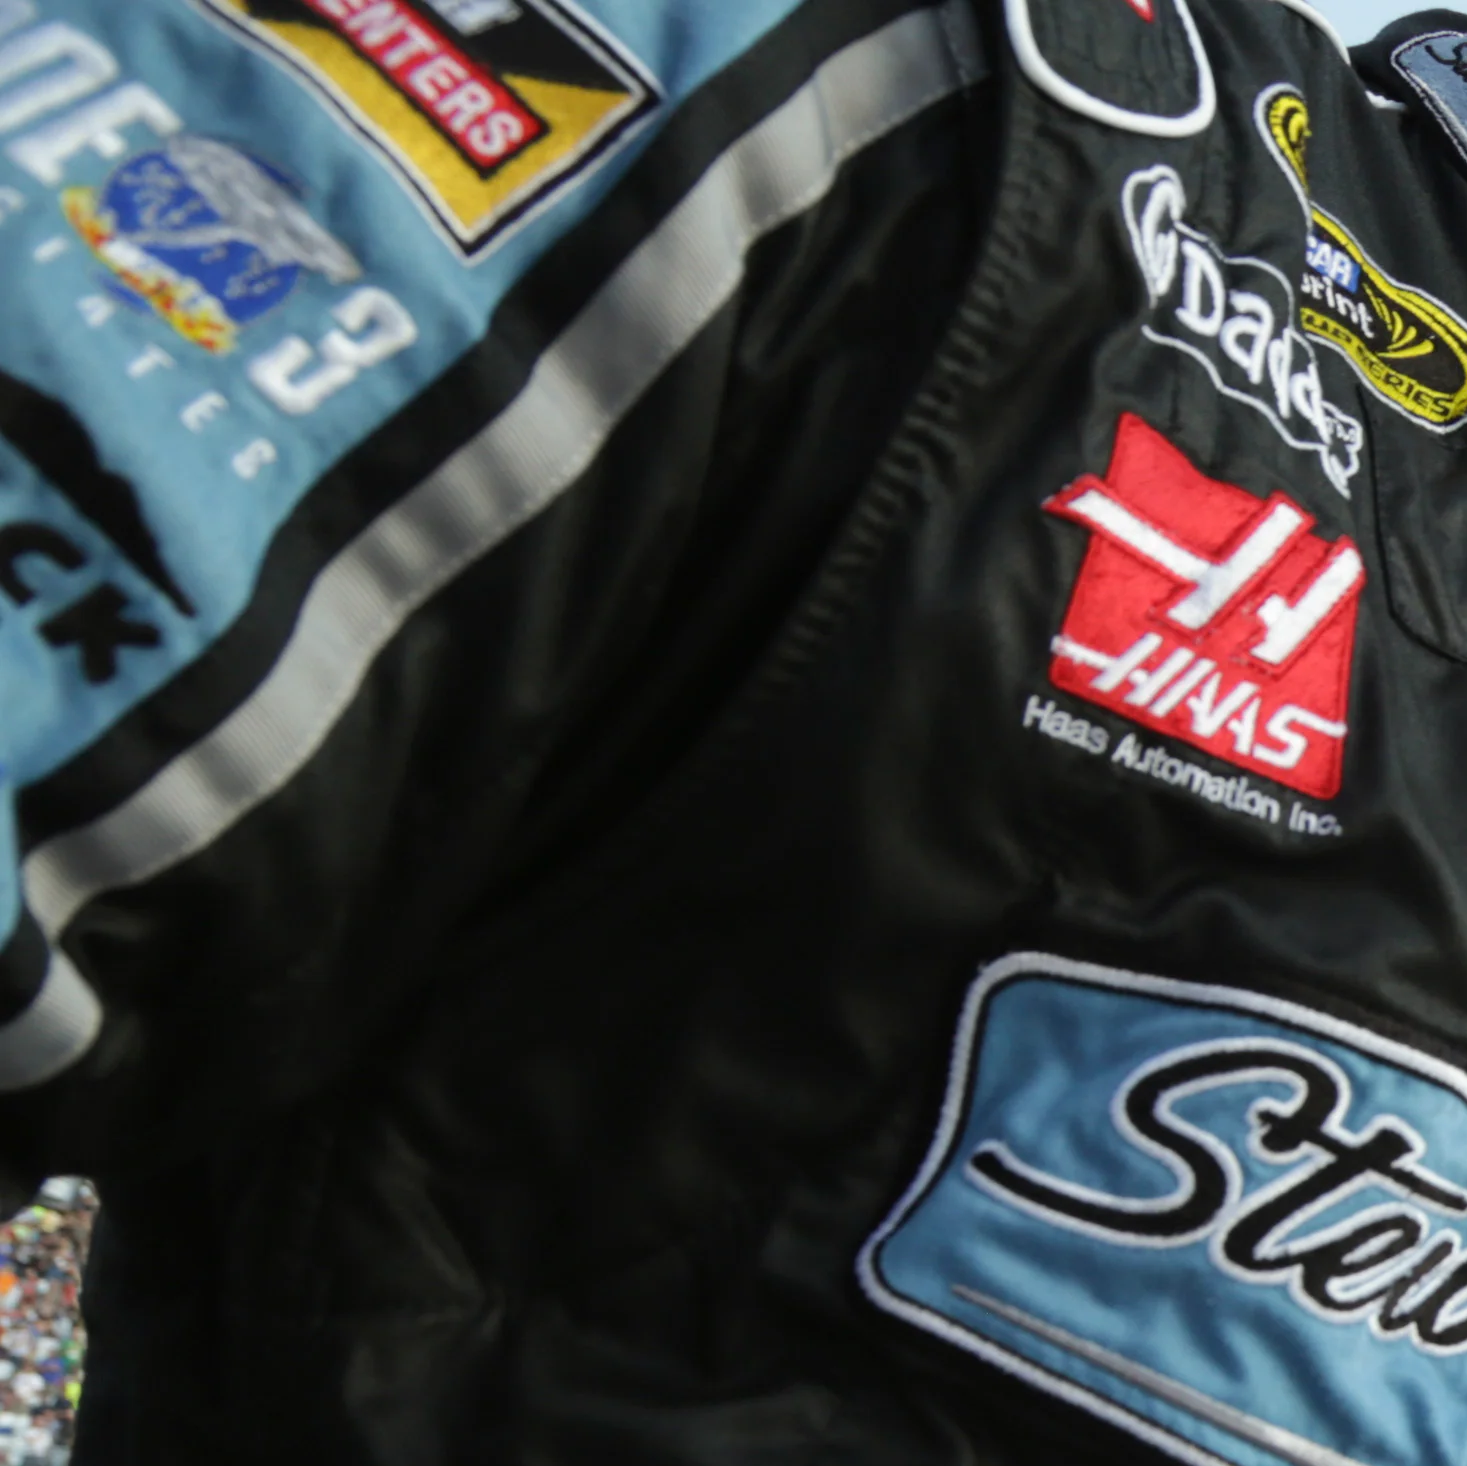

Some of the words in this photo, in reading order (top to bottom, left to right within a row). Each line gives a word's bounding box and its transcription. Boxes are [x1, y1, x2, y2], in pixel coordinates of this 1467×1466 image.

[247, 286, 418, 415] 3
[1022, 695, 1108, 756] Haas
[1112, 732, 1281, 824] Automation
[1050, 633, 1348, 770] HAAS
